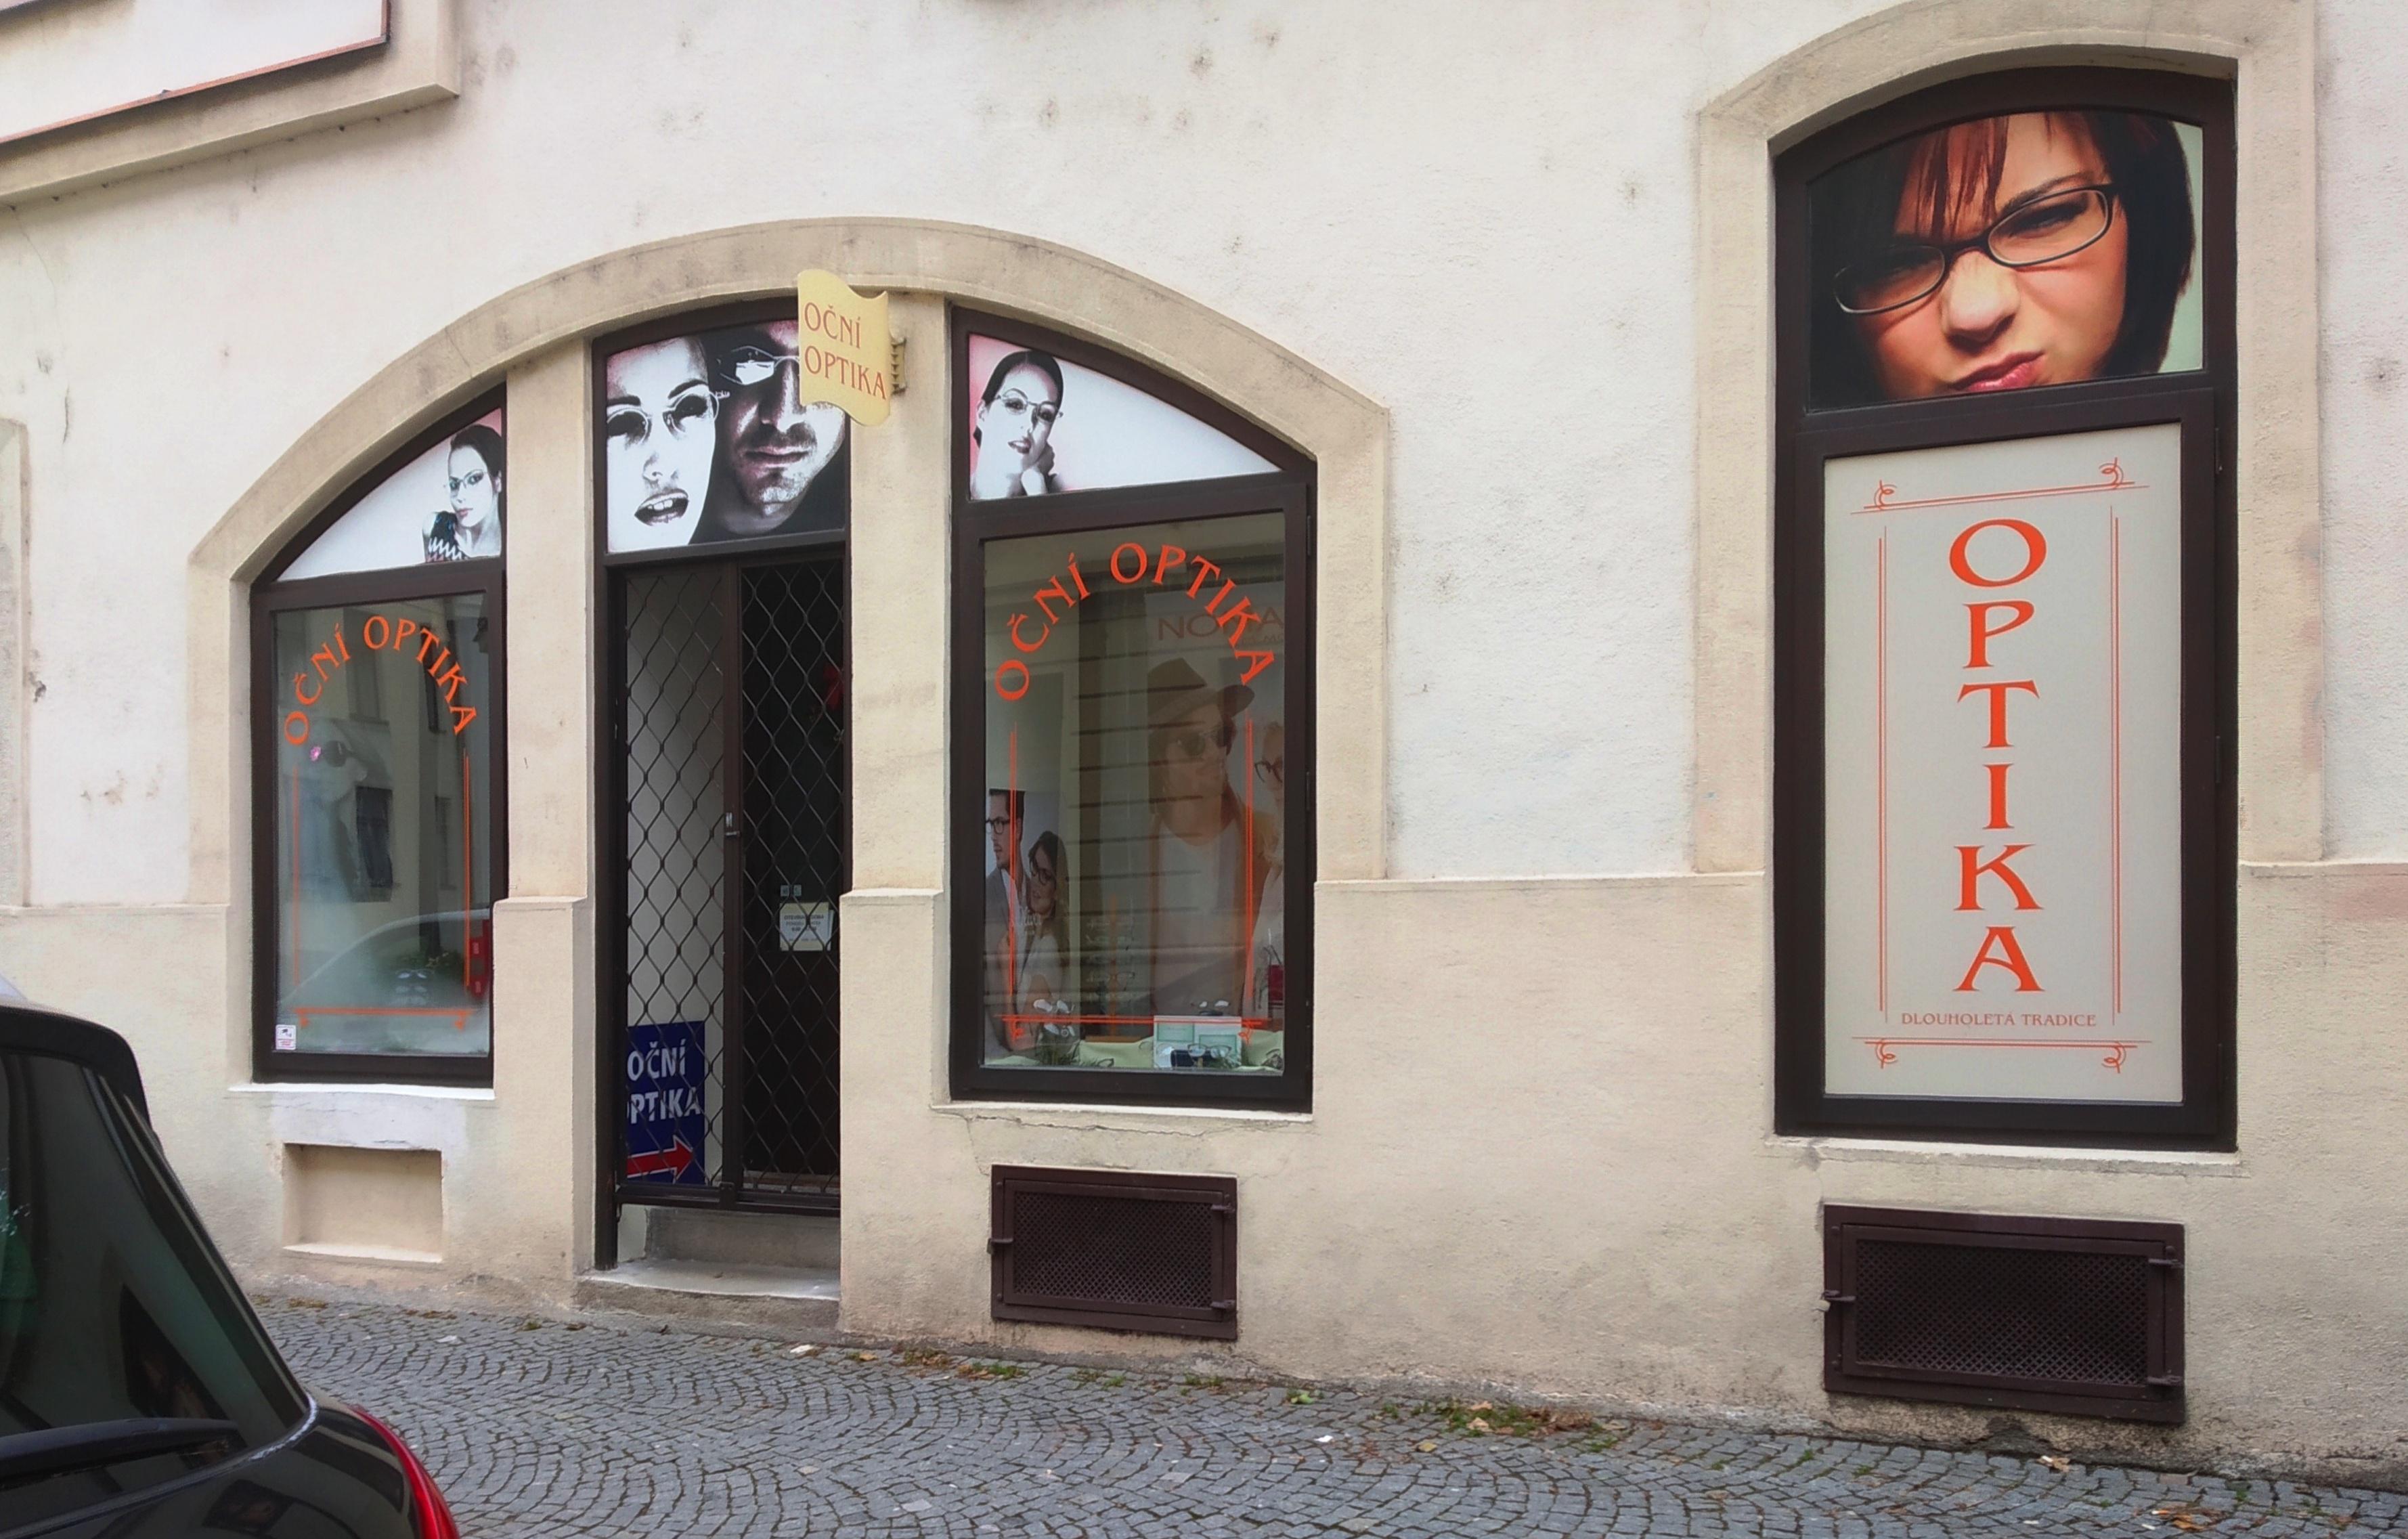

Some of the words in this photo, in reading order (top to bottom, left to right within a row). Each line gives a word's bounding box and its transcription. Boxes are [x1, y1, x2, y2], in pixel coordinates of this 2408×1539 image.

[804, 302, 860, 349] OČNÍ
[804, 345, 886, 400] OPTIKA
[994, 552, 1090, 701] OČNÍ
[1110, 542, 1275, 686] OPTIKA
[284, 623, 351, 745] OČNÍ
[364, 615, 477, 735] OPTIKA
[1948, 518, 2048, 993] OPTIKA
[2022, 1014, 2096, 1026] TRADICE
[628, 1039, 686, 1081] OČNÍ
[627, 1086, 701, 1124] PTIKA
